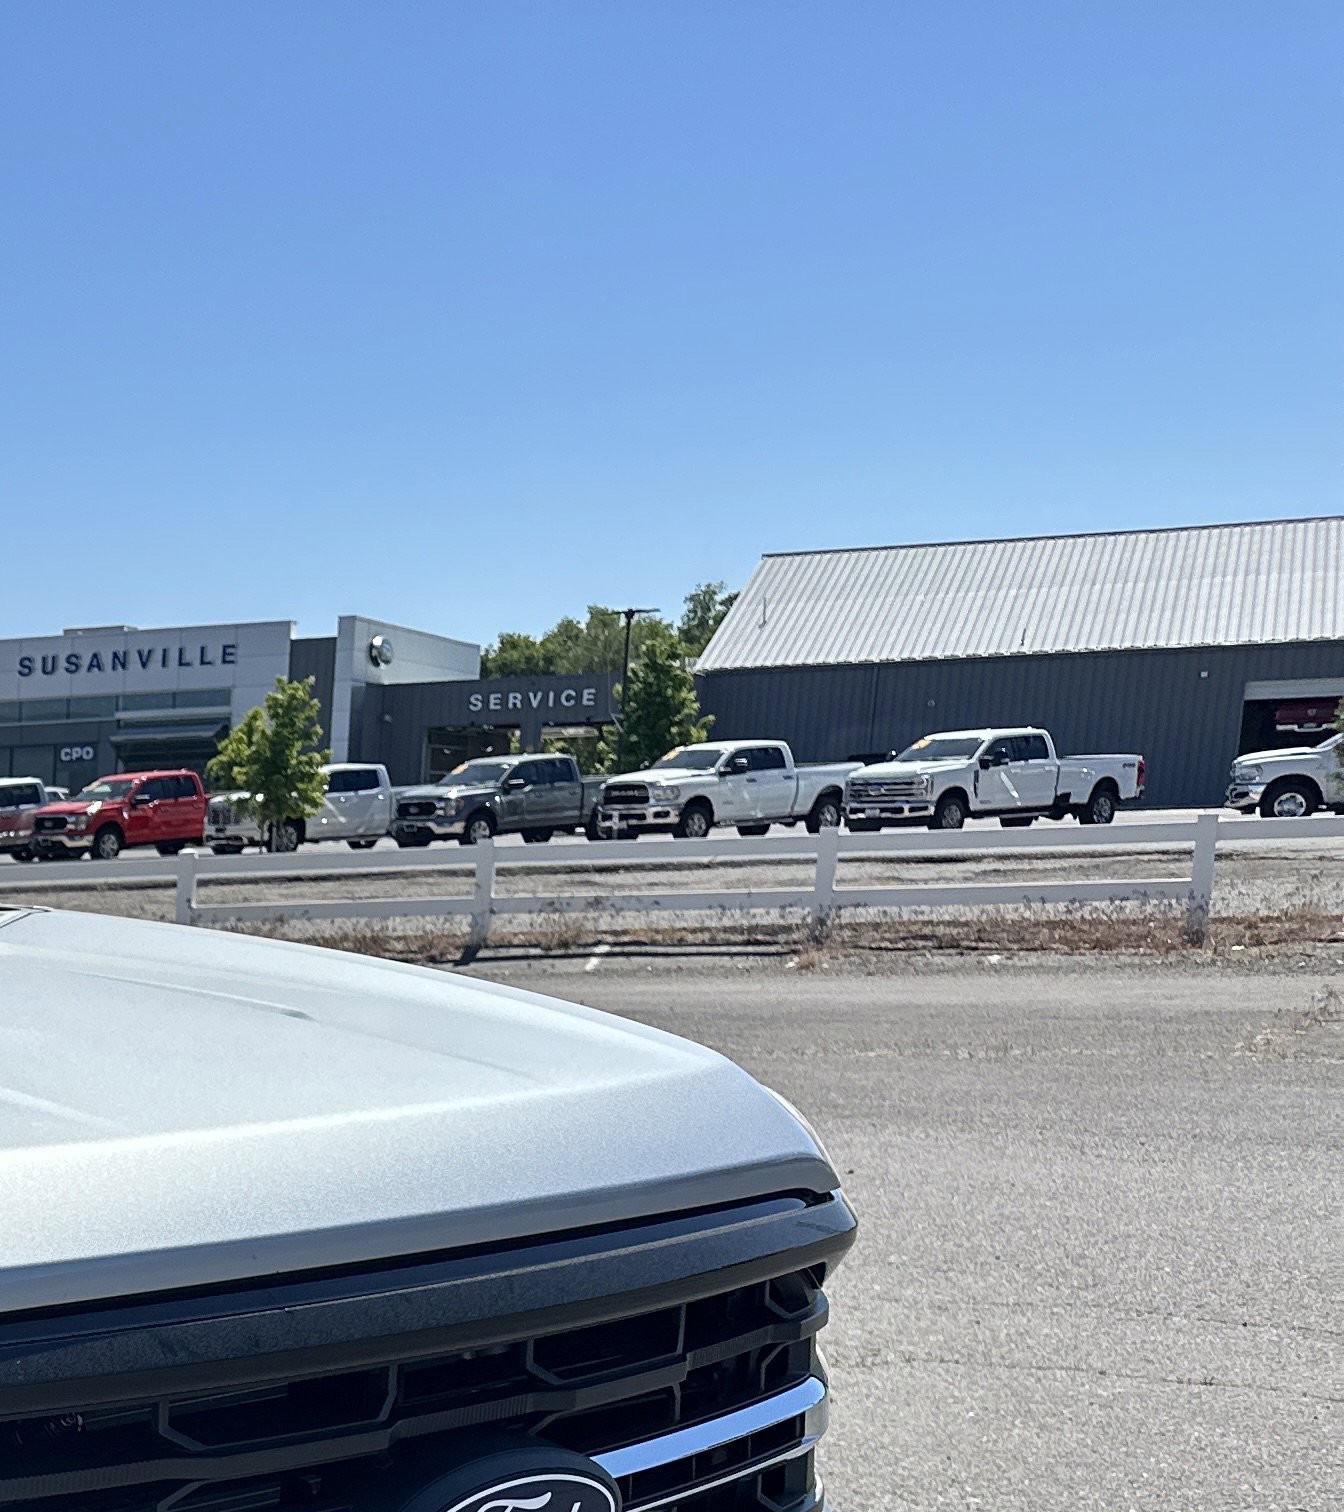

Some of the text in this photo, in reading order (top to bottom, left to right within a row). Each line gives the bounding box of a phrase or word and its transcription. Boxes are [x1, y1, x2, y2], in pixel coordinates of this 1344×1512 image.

[17, 643, 238, 678] SUSANVILLE
[468, 687, 597, 712] SERVICE
[60, 745, 95, 762] CPO
